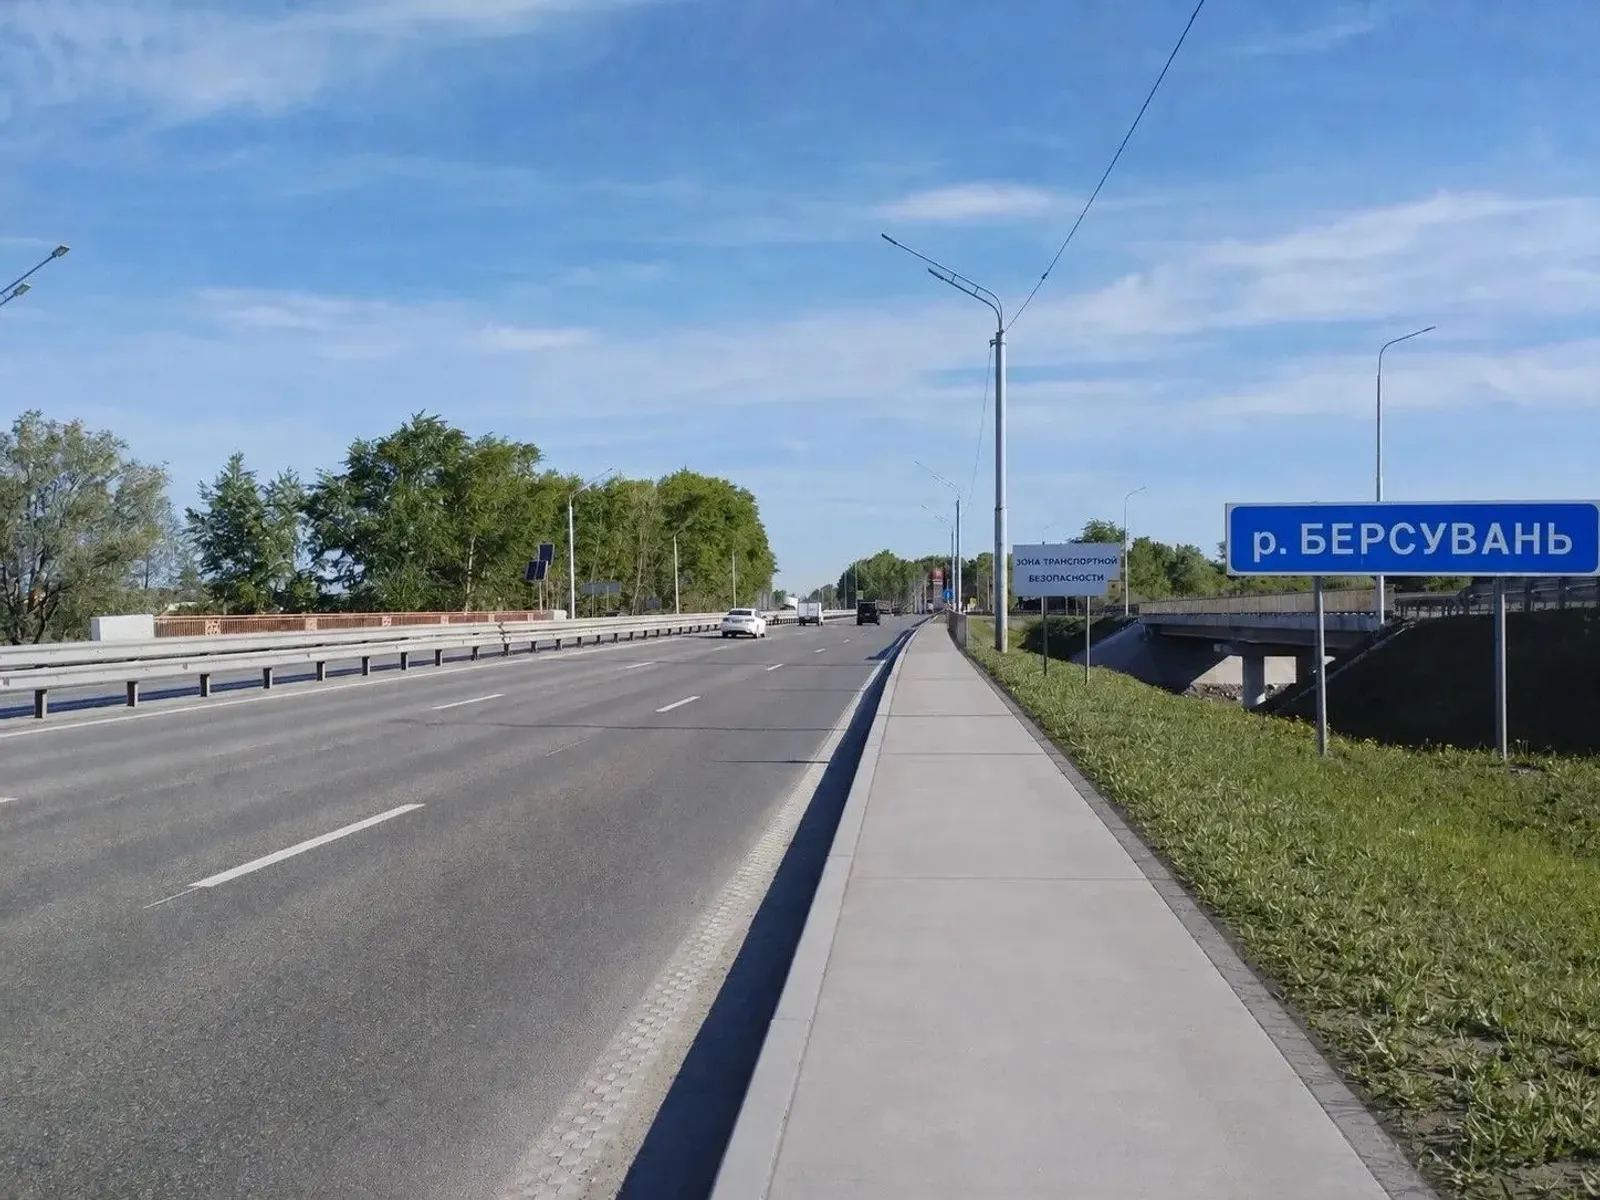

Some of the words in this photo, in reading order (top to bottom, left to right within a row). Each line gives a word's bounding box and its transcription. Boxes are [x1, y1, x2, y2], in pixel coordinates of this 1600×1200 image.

[1253, 530, 1287, 563] р.
[1300, 522, 1573, 556] БЕРСУВАНЬ
[1016, 558, 1041, 566] ЗОНА
[1044, 556, 1118, 566] ТРАНСПОРТНОЙ
[1028, 574, 1105, 583] БЕЗОПАСНОСТИ
